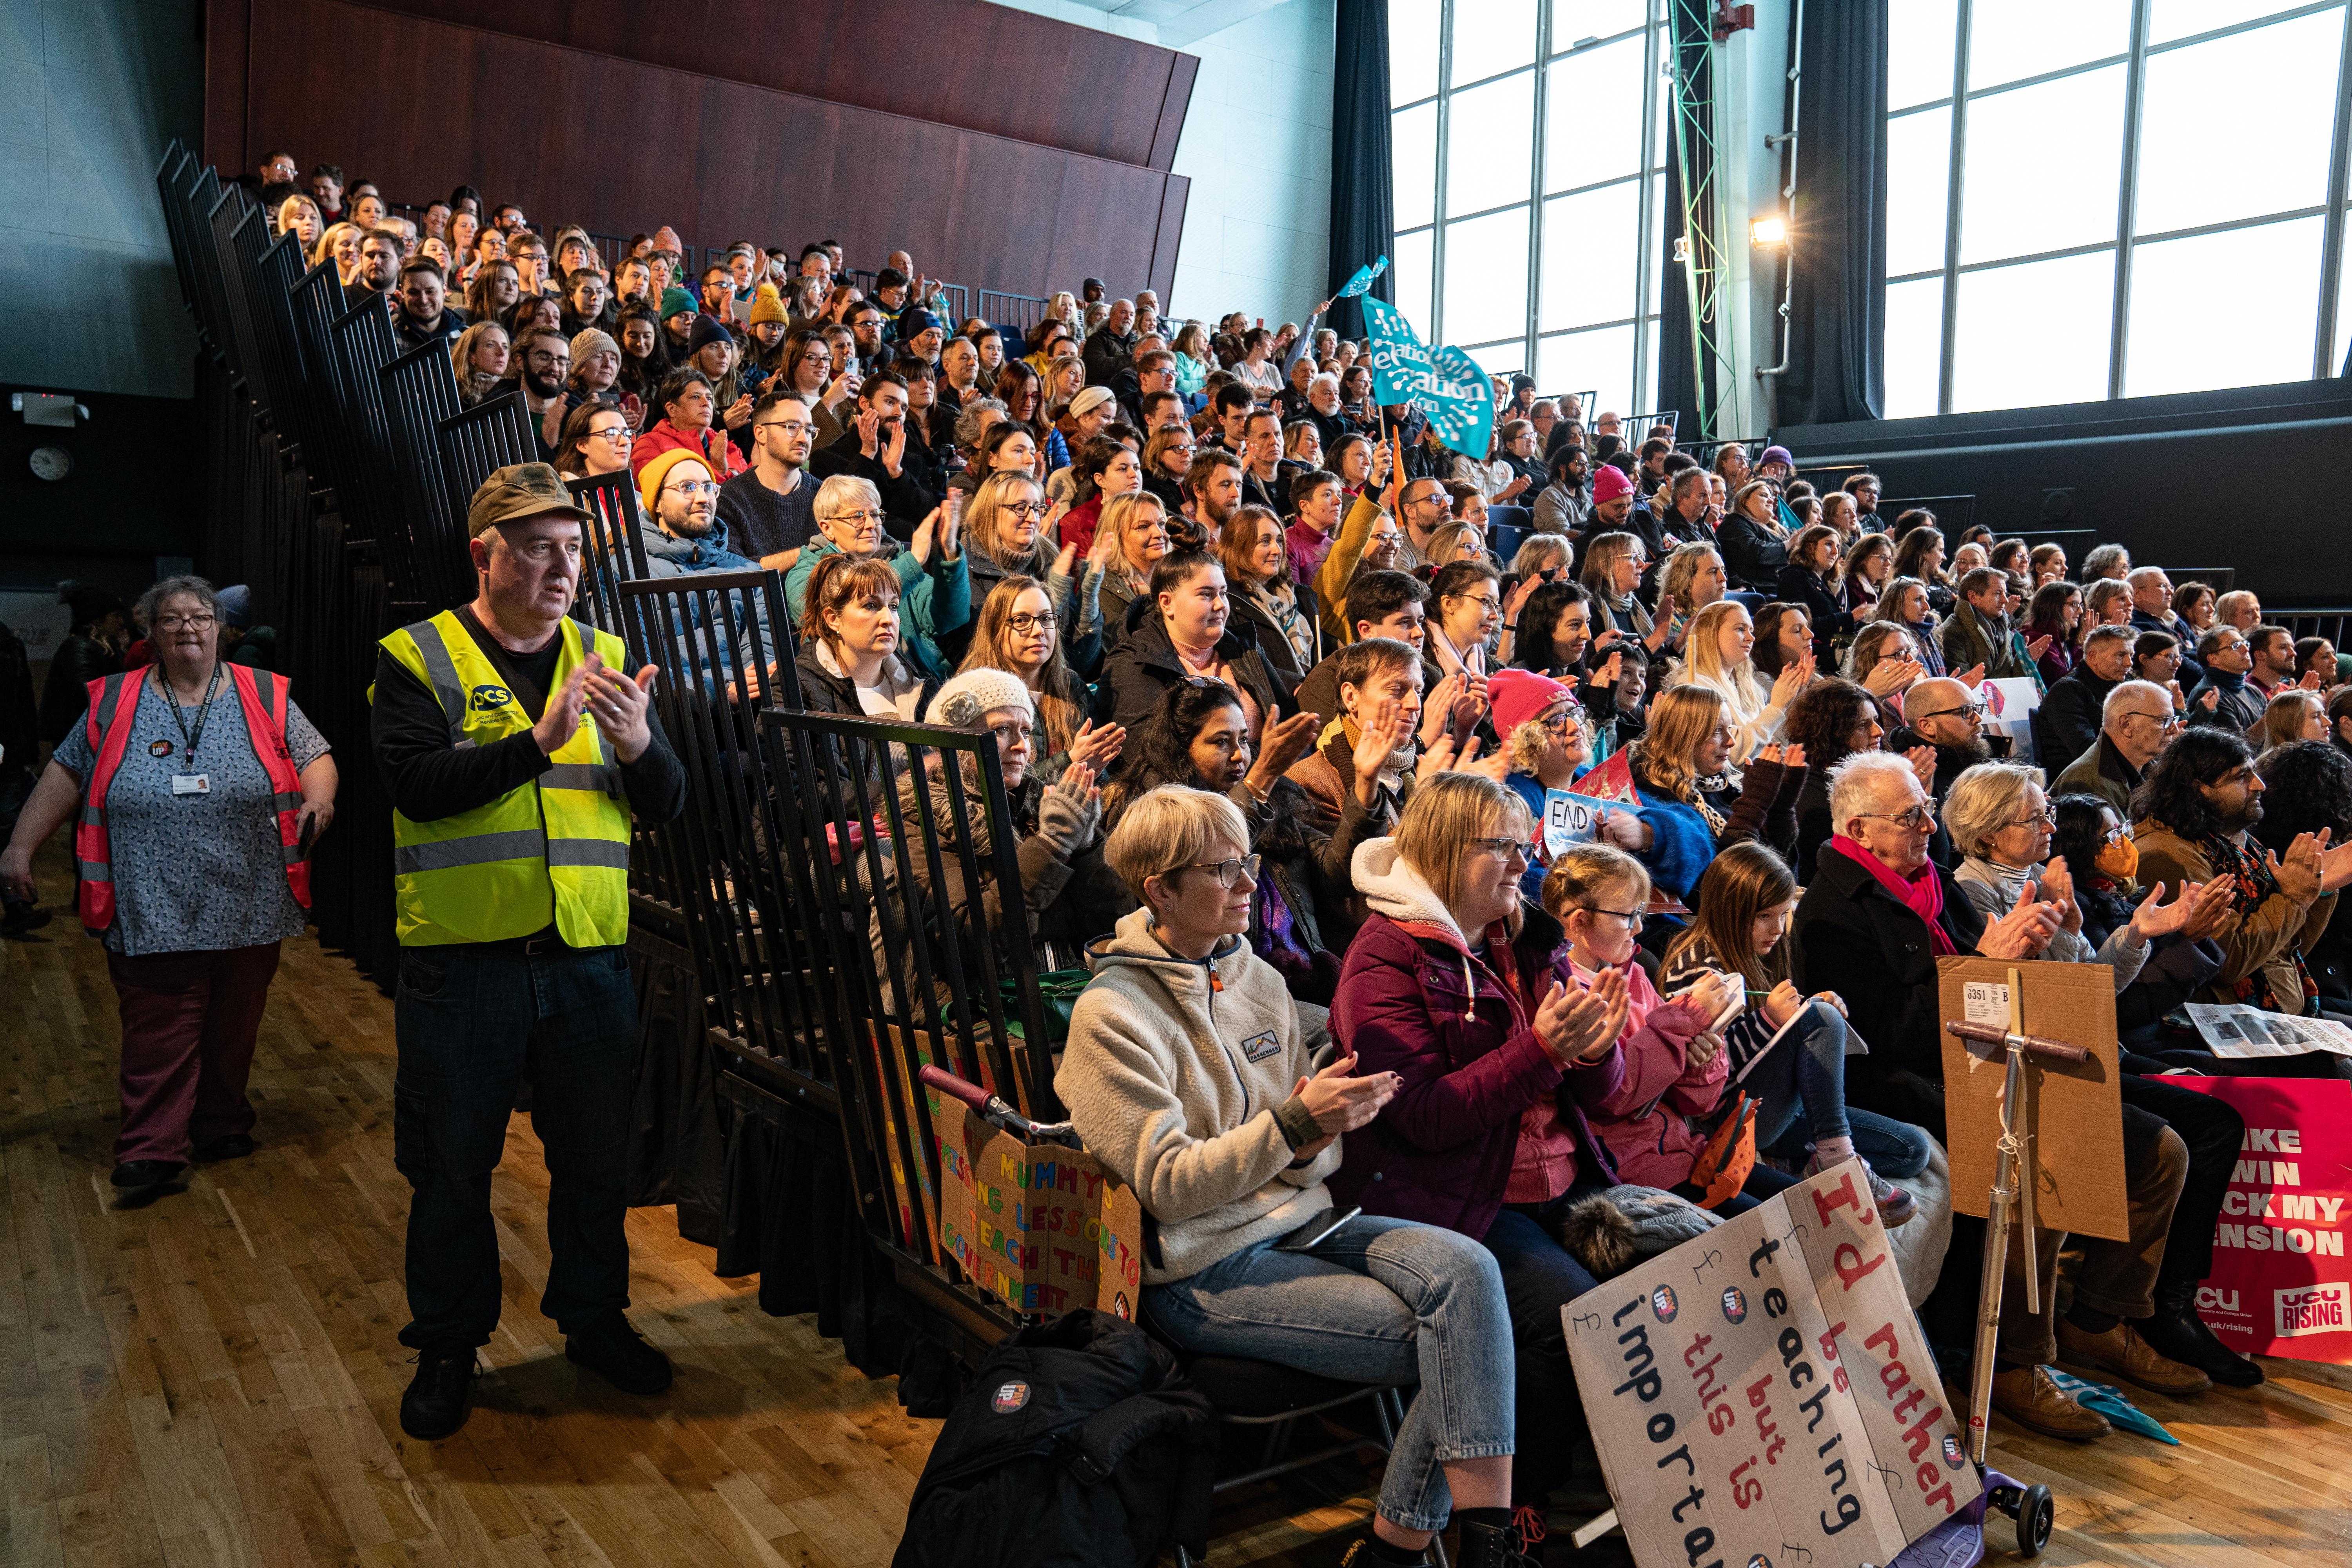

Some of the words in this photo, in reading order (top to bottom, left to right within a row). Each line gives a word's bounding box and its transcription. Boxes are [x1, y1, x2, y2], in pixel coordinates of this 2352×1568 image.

[198, 704, 209, 727] national
[205, 677, 218, 704] education
[1552, 801, 1587, 830] END
[2003, 992, 2008, 1002] B
[1250, 1046, 1278, 1061] PASSENGER
[941, 1140, 1004, 1214] MISSING
[1016, 1203, 1116, 1260] LESSONS
[1120, 1242, 1139, 1287] TO
[2219, 1191, 2276, 1218] CK
[2282, 1194, 2345, 1222] MY
[968, 1207, 1039, 1270] TEACH
[945, 1222, 1069, 1311] GOVERNMENT
[1662, 1287, 1676, 1310] PAY
[1733, 1290, 1744, 1313] PAY
[2194, 1287, 2239, 1311] CU
[2282, 1289, 2341, 1307] UCU
[2283, 1302, 2343, 1330] RISING
[1811, 1172, 1886, 1292] I'd
[1864, 1321, 1956, 1515] rather
[1818, 1321, 1850, 1394] be
[1011, 1385, 1026, 1406] PAY
[1748, 1237, 1862, 1536] teaching
[1684, 1333, 1735, 1436] this
[1729, 1455, 1763, 1510] is
[1746, 1374, 1789, 1466] but
[1953, 1438, 1963, 1460] PAY
